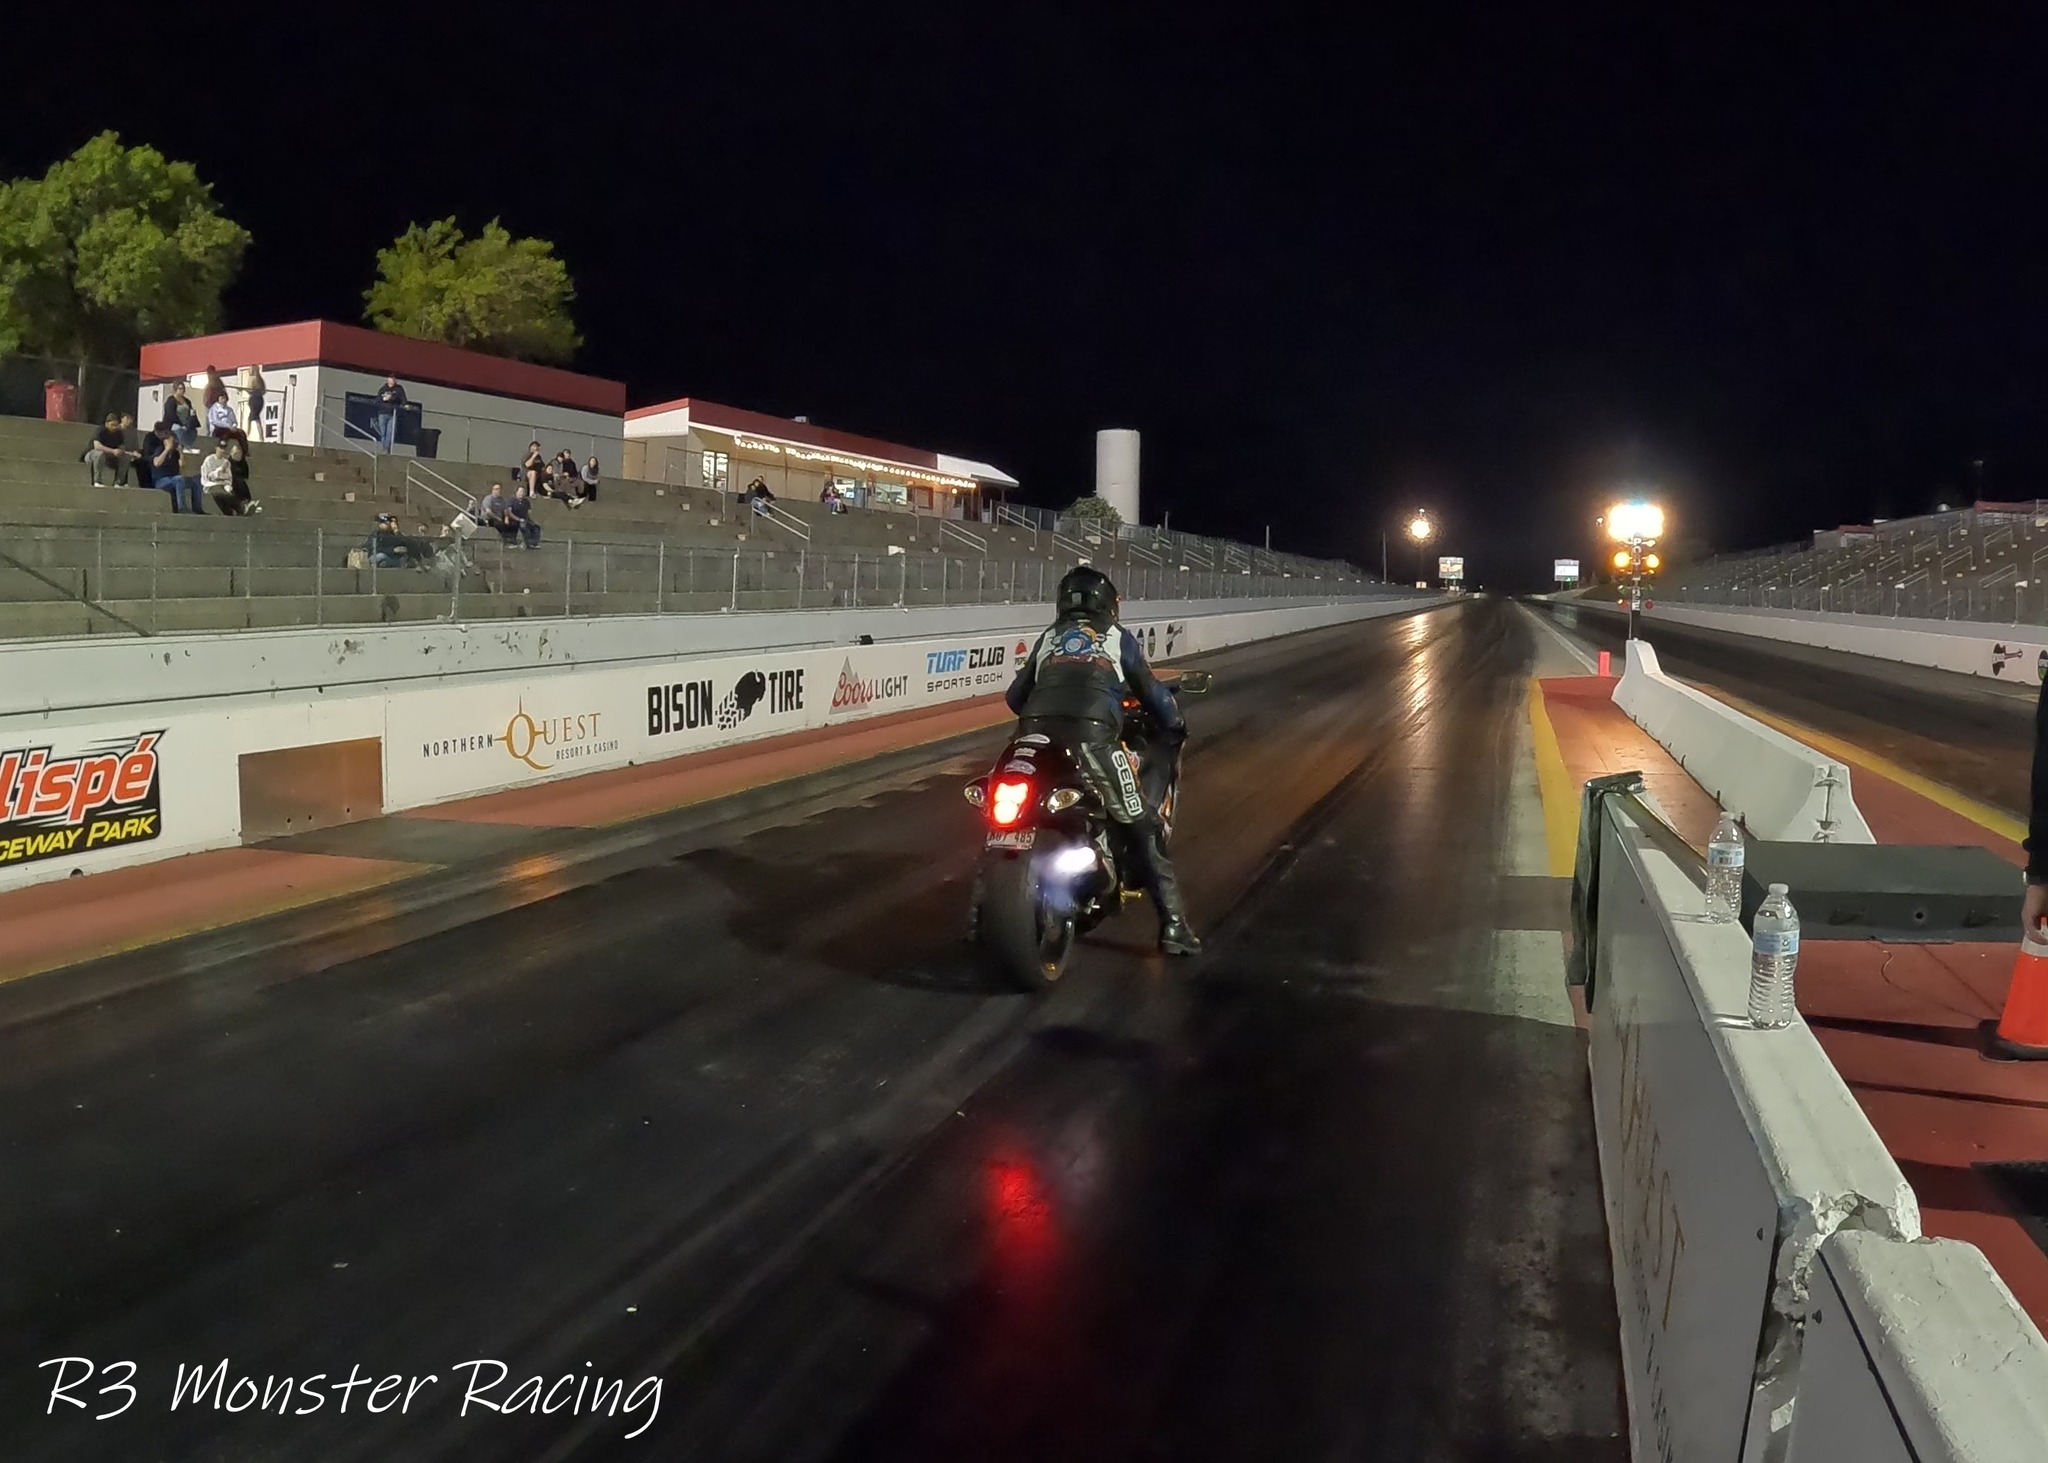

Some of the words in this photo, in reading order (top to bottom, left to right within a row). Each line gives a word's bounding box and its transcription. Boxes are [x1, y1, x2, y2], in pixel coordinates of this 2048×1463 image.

[264, 404, 279, 443] ME
[926, 650, 967, 675] TURF
[968, 646, 1005, 669] CLUB
[832, 672, 874, 708] Coors
[875, 675, 908, 700] LIGHT
[927, 677, 971, 693] SPORTS
[975, 671, 1003, 685] BOOK
[647, 679, 713, 736] BISON
[769, 669, 804, 714] TIRE
[423, 733, 493, 758] NORTHERN
[500, 700, 601, 770] QUEST
[556, 745, 583, 760] RESORT
[586, 744, 591, 755] &
[593, 739, 619, 753] CASINO
[86, 815, 157, 848] PARK
